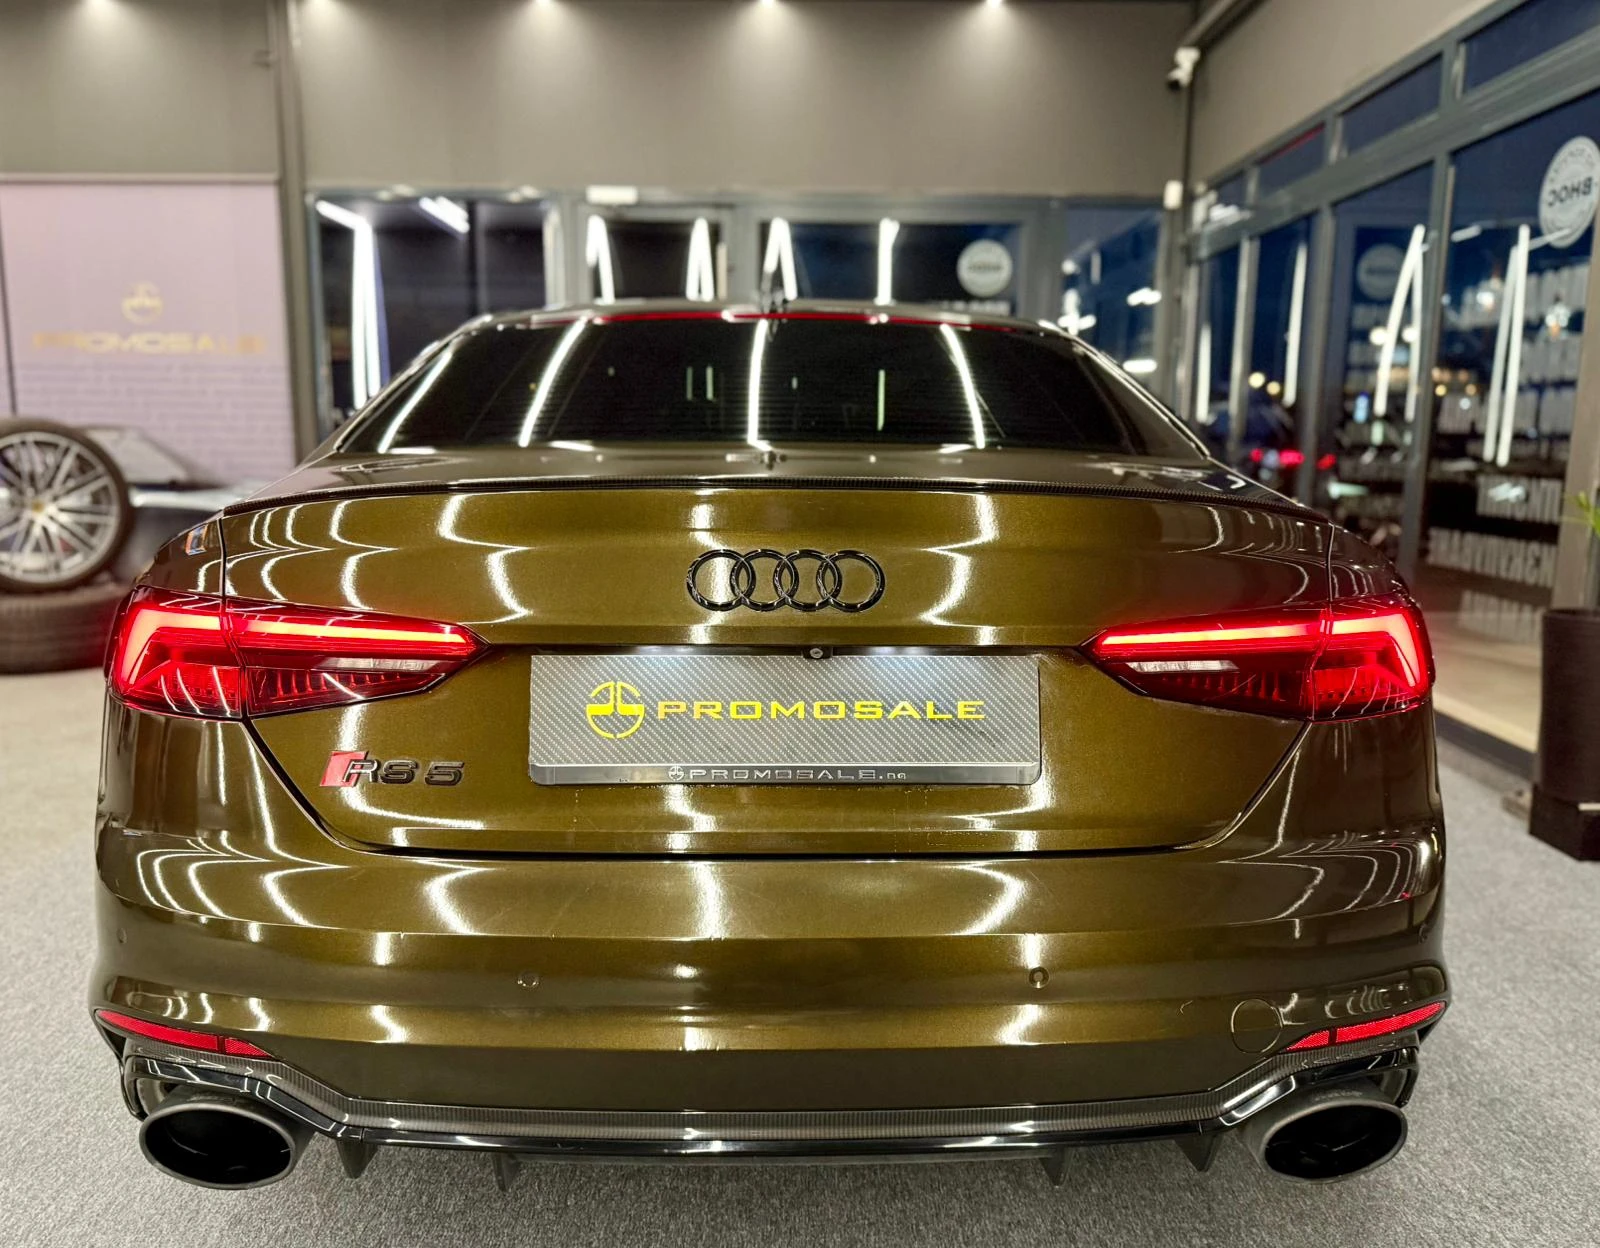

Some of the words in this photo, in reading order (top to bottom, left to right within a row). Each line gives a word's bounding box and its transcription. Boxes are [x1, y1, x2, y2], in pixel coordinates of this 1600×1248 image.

[657, 700, 986, 720] PROMOSALE
[341, 758, 419, 785] RS
[424, 761, 465, 786] 5
